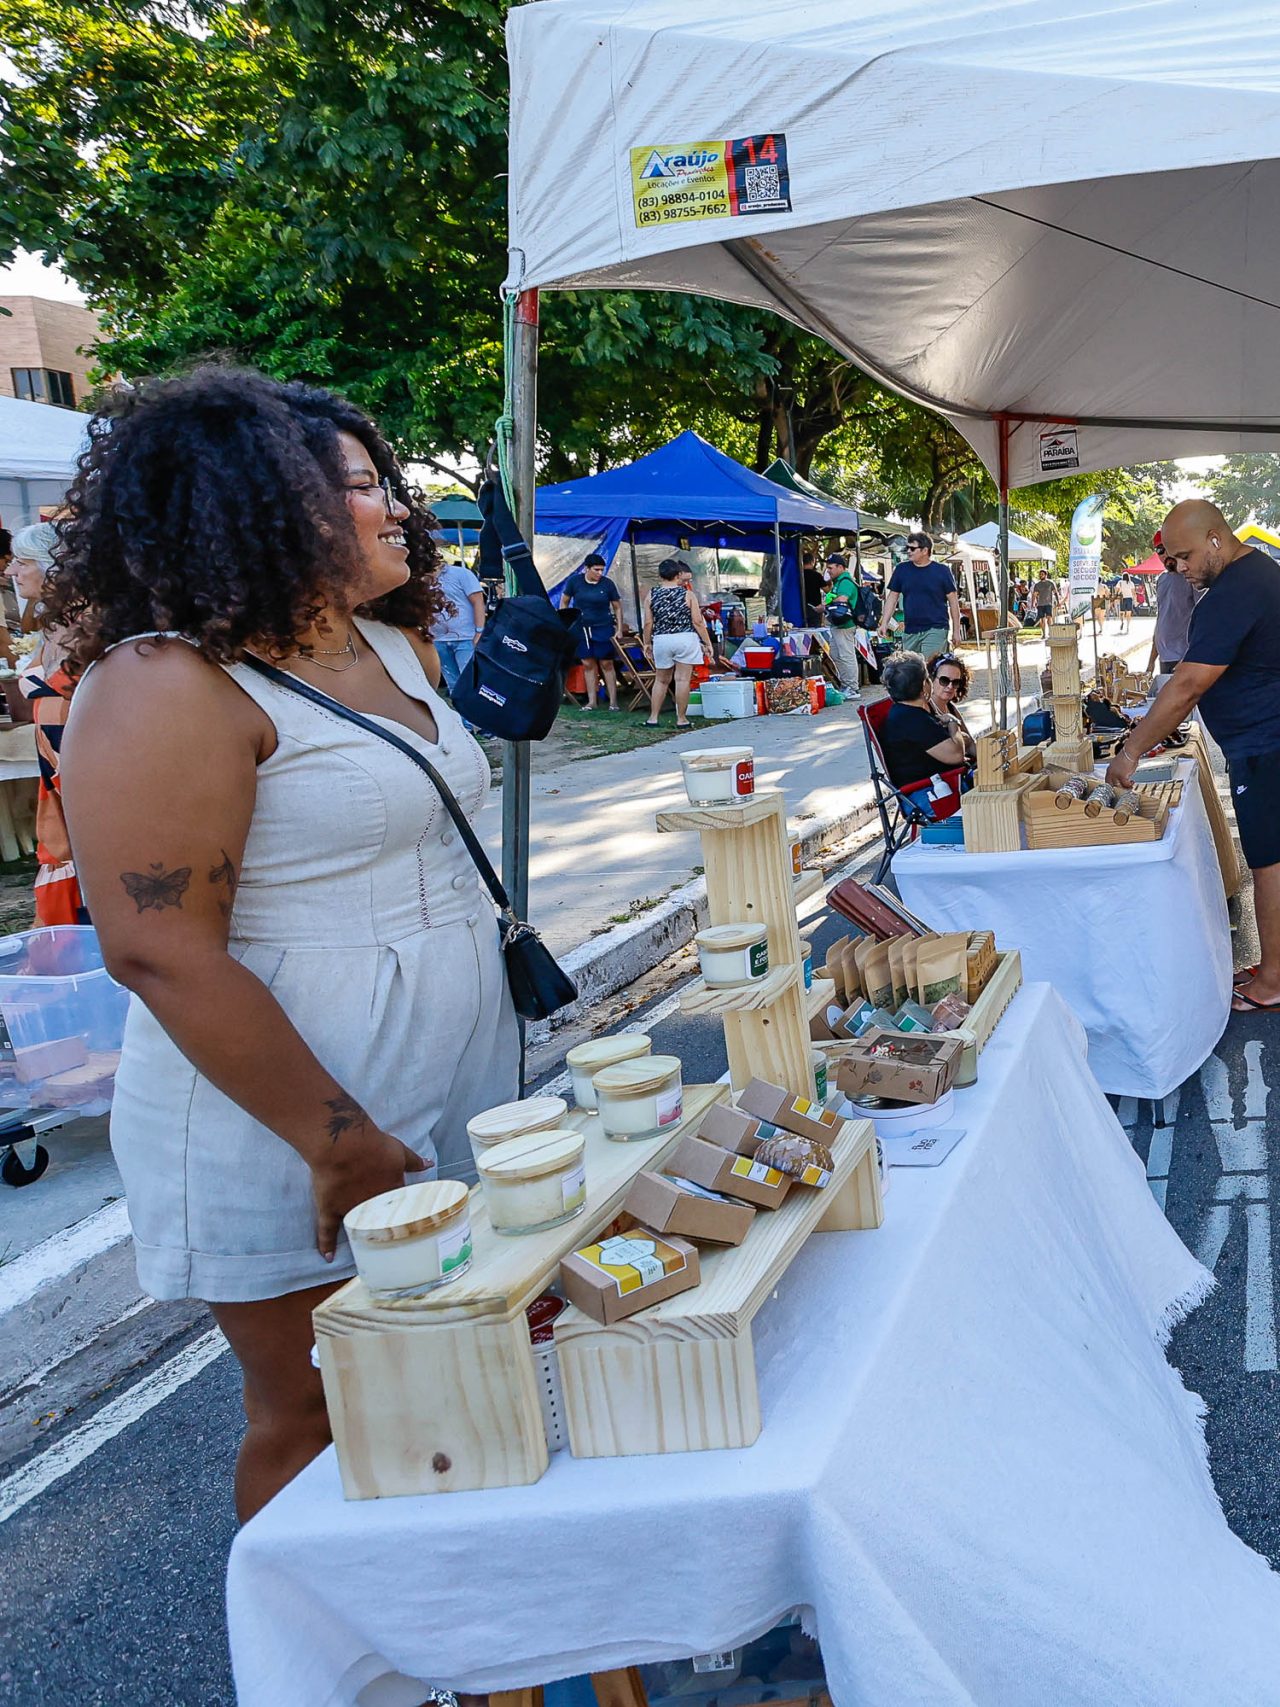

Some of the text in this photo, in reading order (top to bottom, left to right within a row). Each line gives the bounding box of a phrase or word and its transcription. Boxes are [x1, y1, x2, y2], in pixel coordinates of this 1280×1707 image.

[742, 135, 778, 165] 14
[640, 150, 719, 179] Araújo
[647, 178, 680, 189] Locações
[687, 175, 716, 185] Eventos
[638, 189, 726, 209] (83) 98894-0104
[639, 203, 728, 224] (83) 98755-7662
[1043, 447, 1076, 458] PARAÍBA
